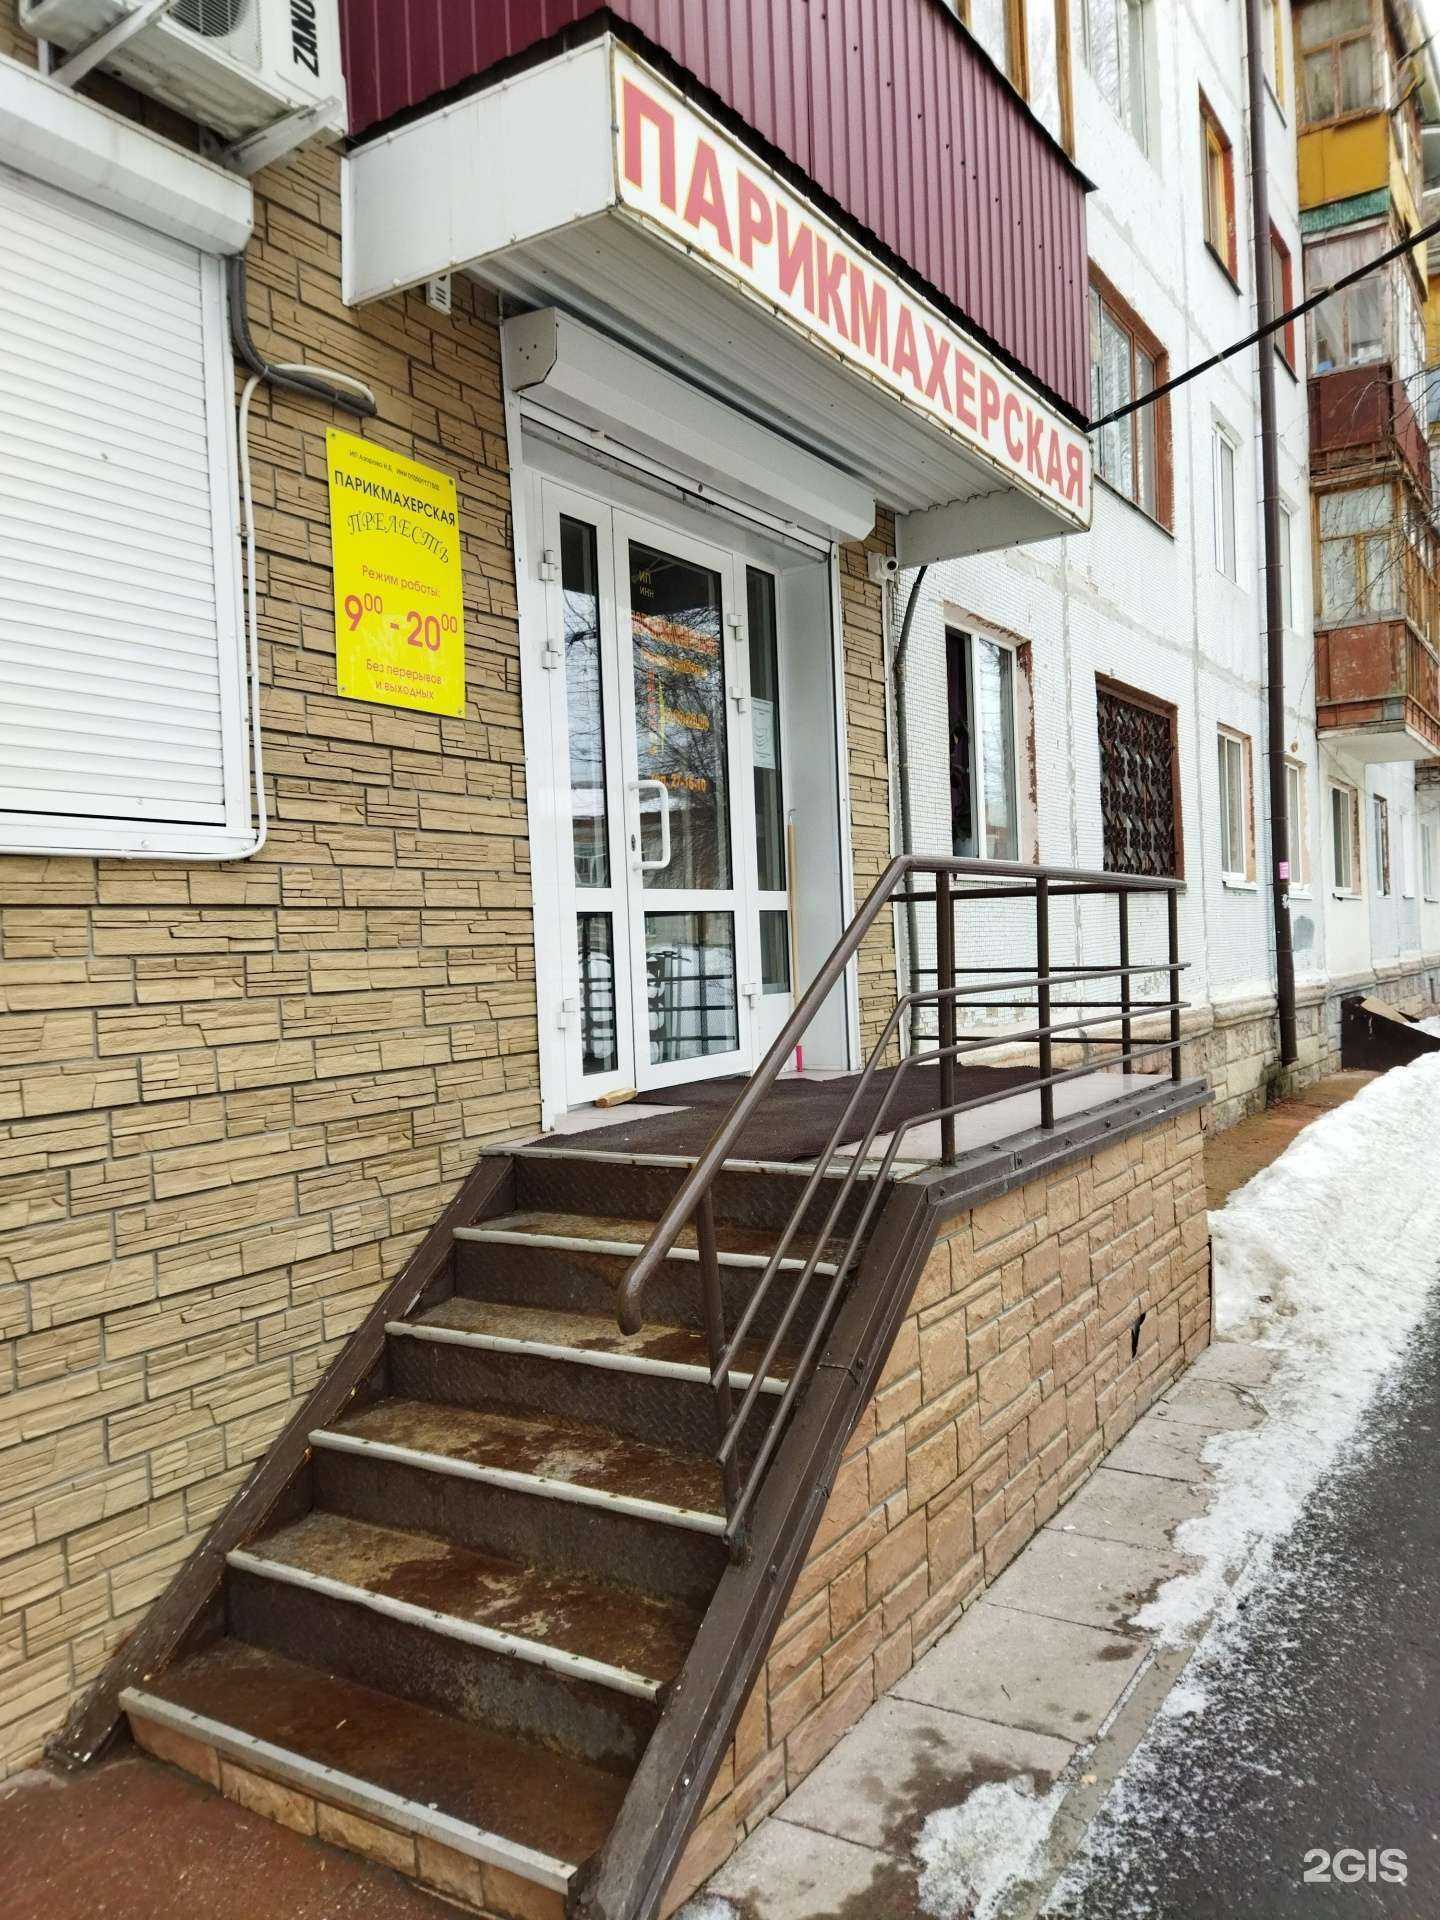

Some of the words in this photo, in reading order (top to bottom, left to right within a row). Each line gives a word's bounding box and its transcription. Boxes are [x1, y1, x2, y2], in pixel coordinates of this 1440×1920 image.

[290, 0, 319, 77] ZANU
[621, 77, 1085, 509] ПАРИКМАХЕРСКАЯ
[334, 469, 456, 526] ПАРИКМАХЕРСКАЯ
[347, 511, 450, 564] ПРЕЛЕСТЬ
[362, 564, 399, 587] Режим
[400, 578, 440, 598] работы:
[366, 659, 385, 675] Без
[386, 664, 442, 685] перерывов
[375, 681, 383, 690] и
[384, 682, 435, 701] выходных
